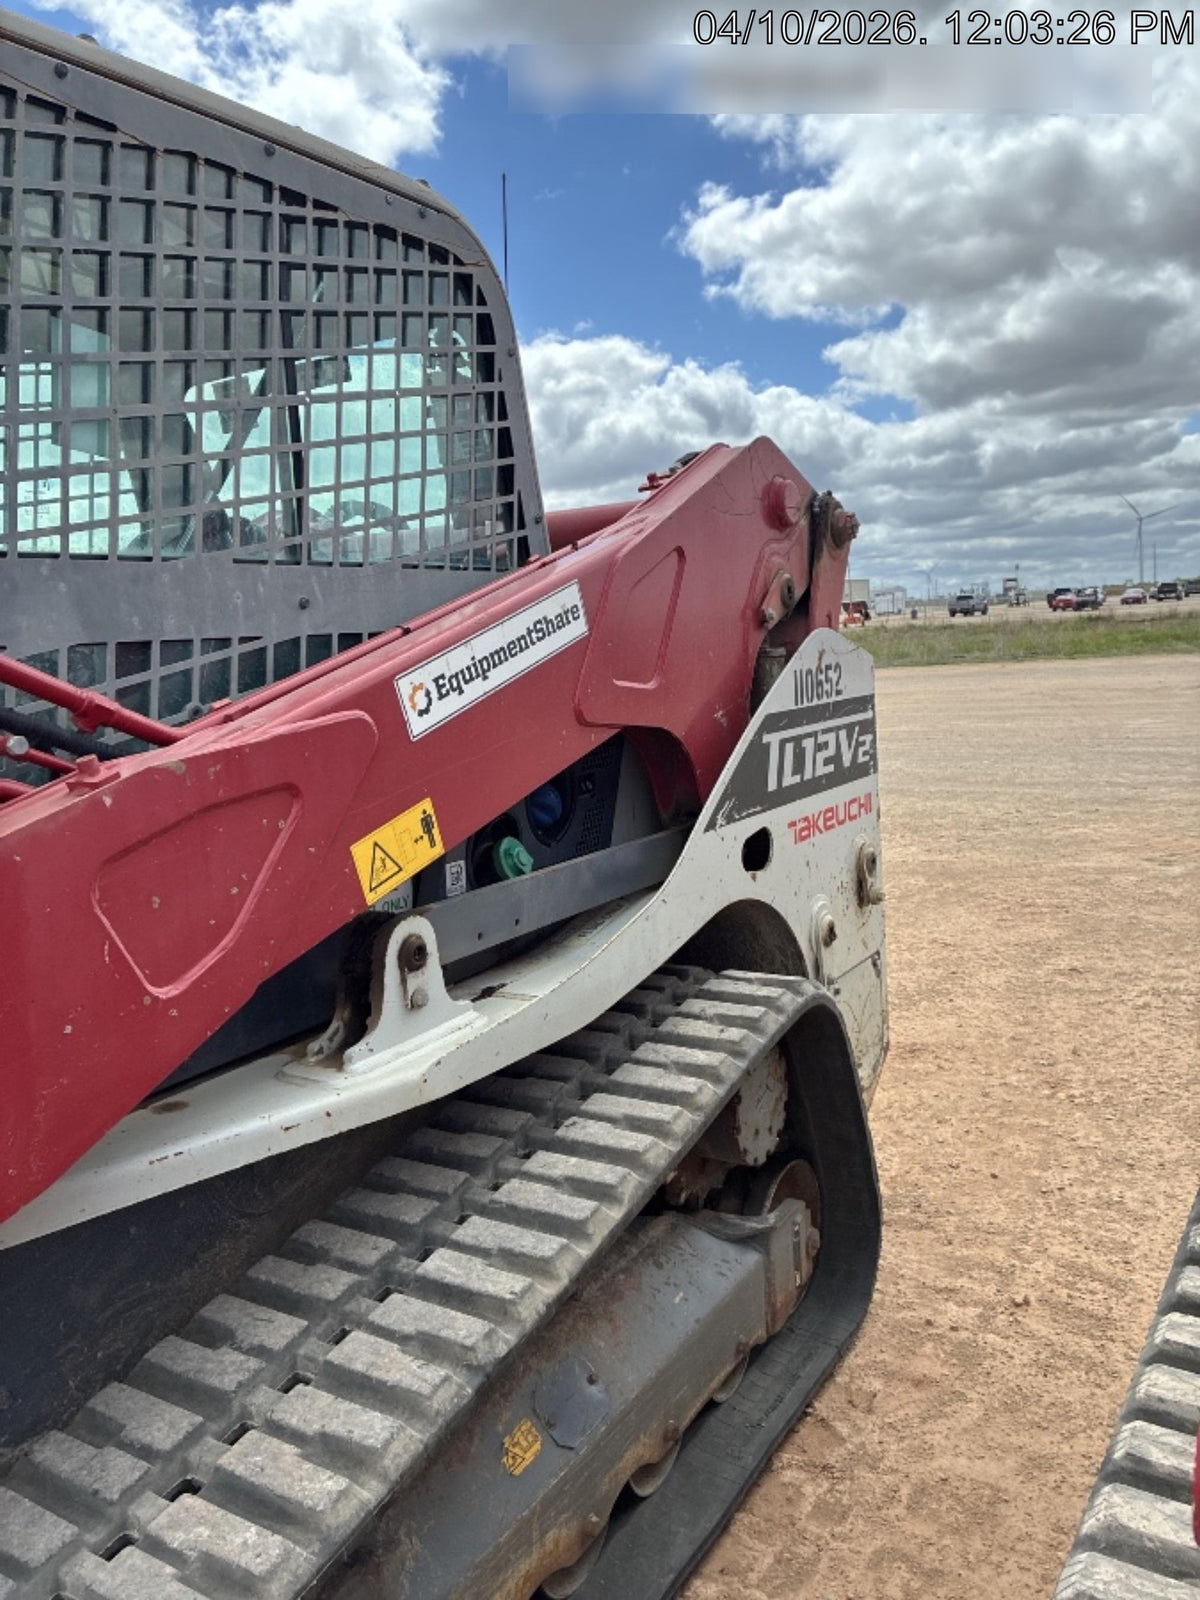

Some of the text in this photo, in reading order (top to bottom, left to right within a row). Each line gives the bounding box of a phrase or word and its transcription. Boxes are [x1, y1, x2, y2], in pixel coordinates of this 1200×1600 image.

[431, 603, 581, 701] EquipmentShare
[794, 662, 843, 707] 110652
[762, 726, 874, 793] TL12V2
[787, 792, 872, 846] TAKEUCHI
